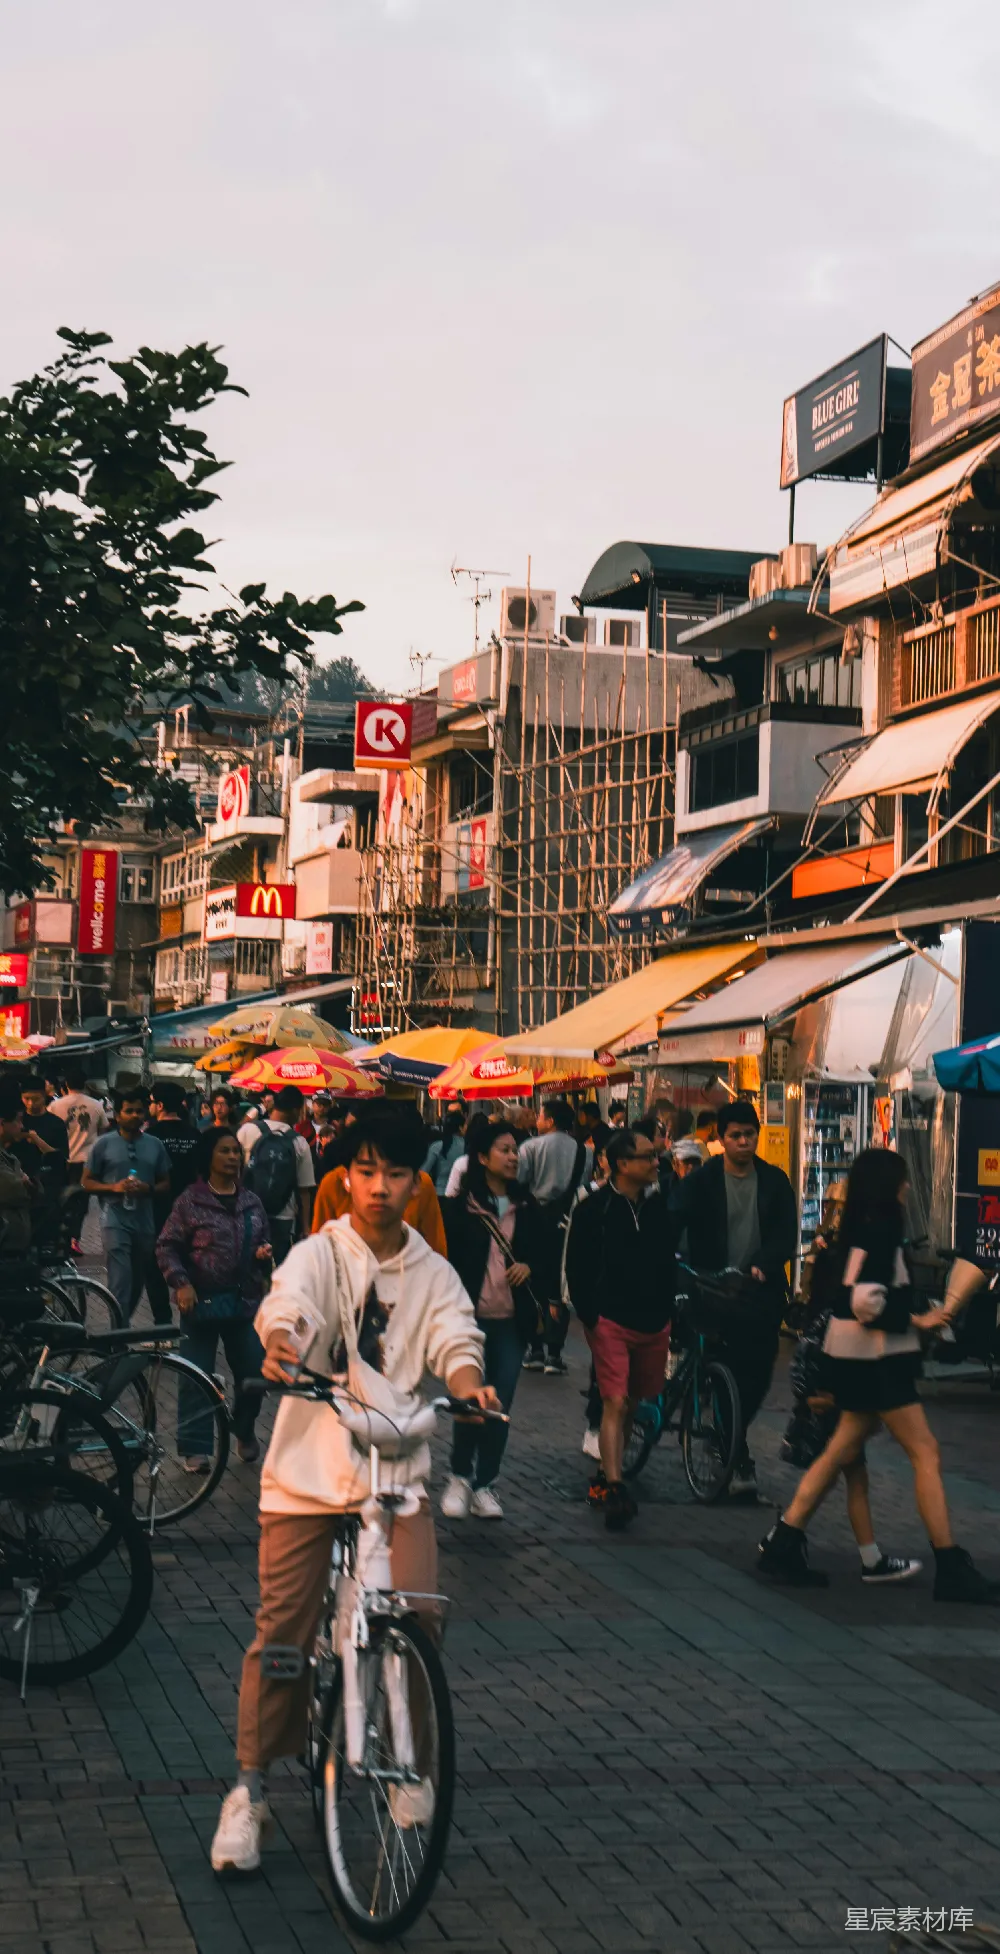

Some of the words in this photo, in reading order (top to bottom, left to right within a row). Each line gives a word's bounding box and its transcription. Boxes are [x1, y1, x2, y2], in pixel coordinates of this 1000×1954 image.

[812, 395, 835, 431] BLUE
[835, 379, 859, 414] GIRL
[375, 717, 402, 751] K
[90, 879, 105, 950] wellcome
